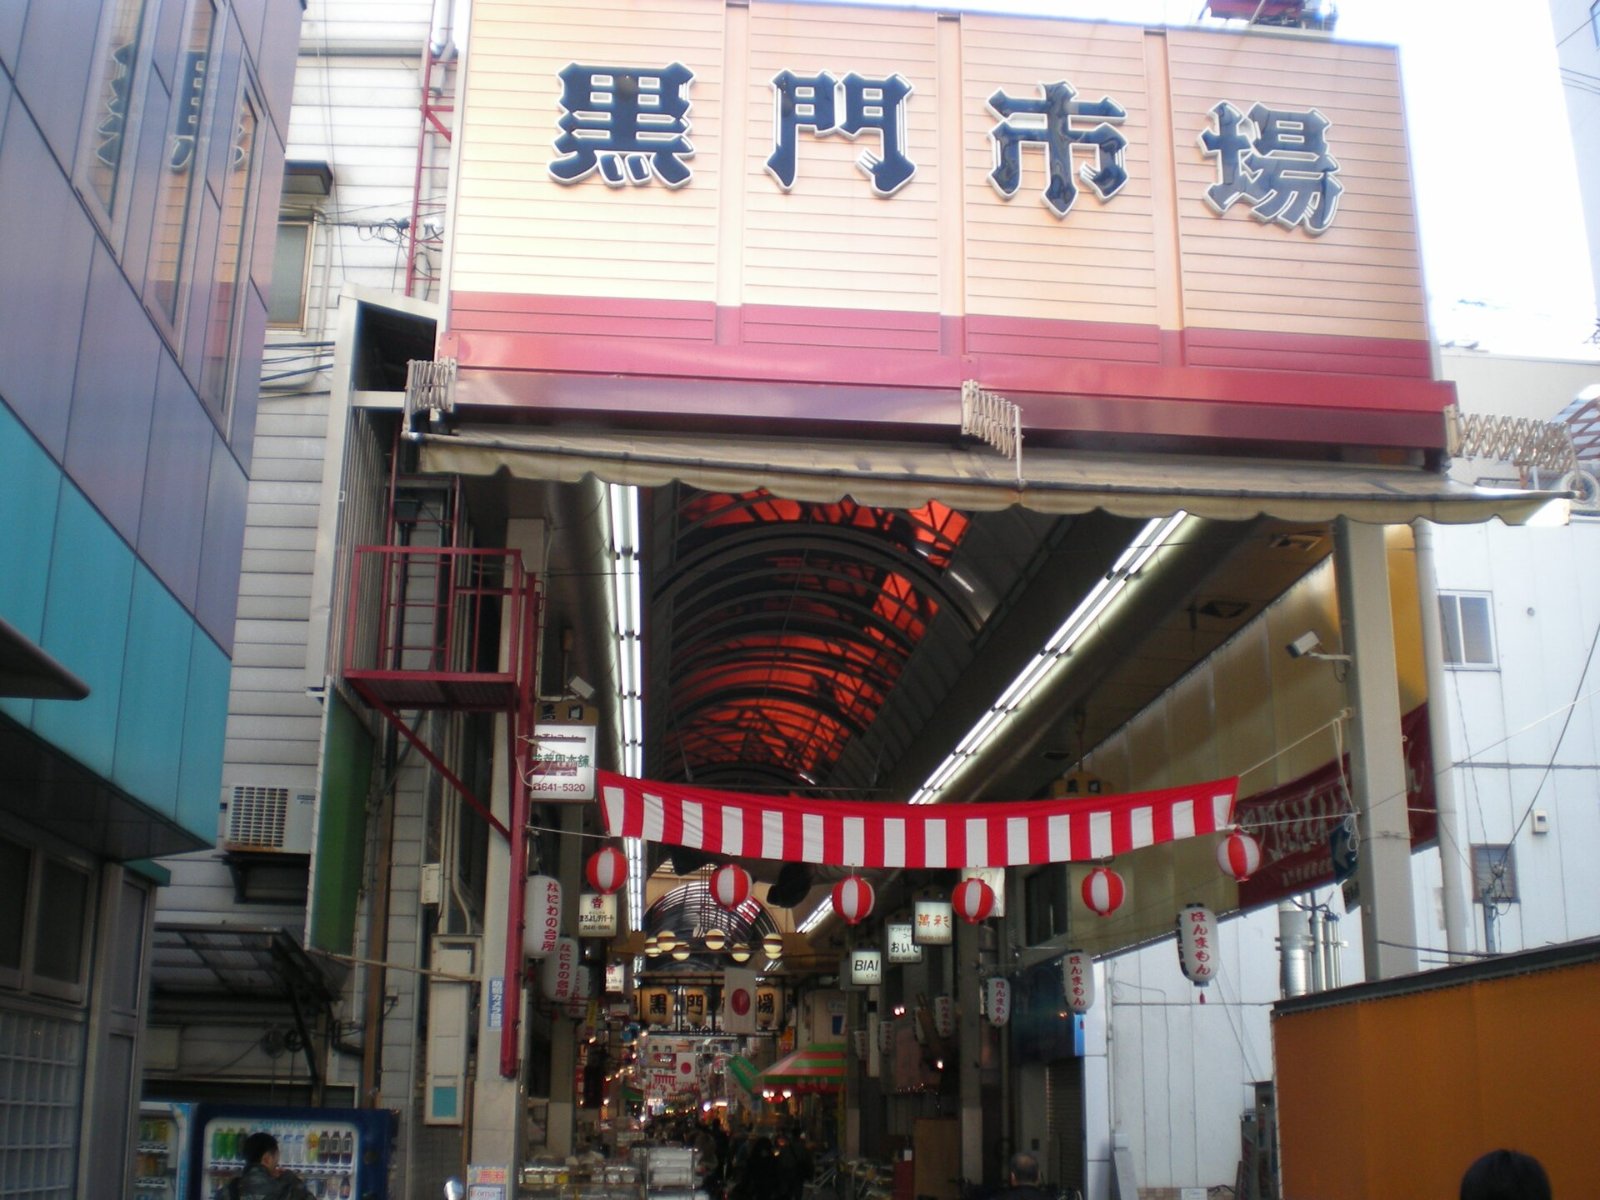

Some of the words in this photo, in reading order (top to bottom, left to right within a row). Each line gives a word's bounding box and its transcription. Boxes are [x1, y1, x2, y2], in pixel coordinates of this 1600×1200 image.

[548, 61, 1344, 236] 黒門市場
[541, 882, 560, 952] なにわの台所
[1190, 912, 1211, 975] ほんまもん
[555, 943, 572, 997] なにわの台所
[854, 960, 879, 971] BIAI
[1069, 956, 1086, 1006] ほんまもん
